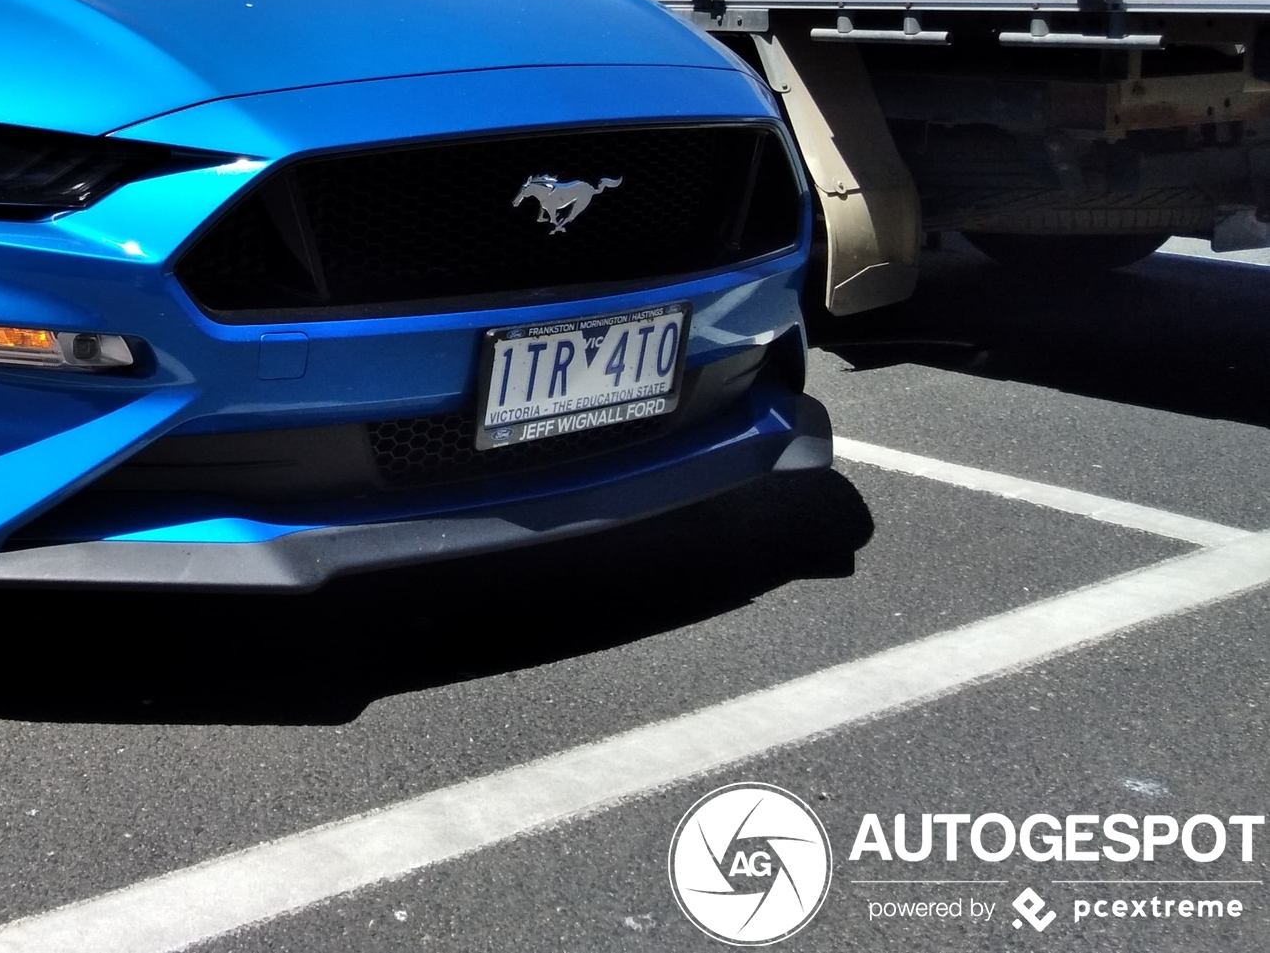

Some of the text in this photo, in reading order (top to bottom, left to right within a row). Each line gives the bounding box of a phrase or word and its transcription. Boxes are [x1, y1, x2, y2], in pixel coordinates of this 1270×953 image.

[528, 324, 575, 336] FRANKSTON
[580, 315, 628, 329] MORNINGTON
[632, 307, 664, 321] HASTINGS
[584, 336, 604, 349] VIC
[499, 341, 576, 406] 1TR
[490, 406, 541, 424] VICTORIA
[552, 399, 573, 413] THE
[576, 388, 634, 408] EDUCATION
[636, 382, 666, 396] STATE
[519, 398, 666, 441] JEFF WIGNALL FORD
